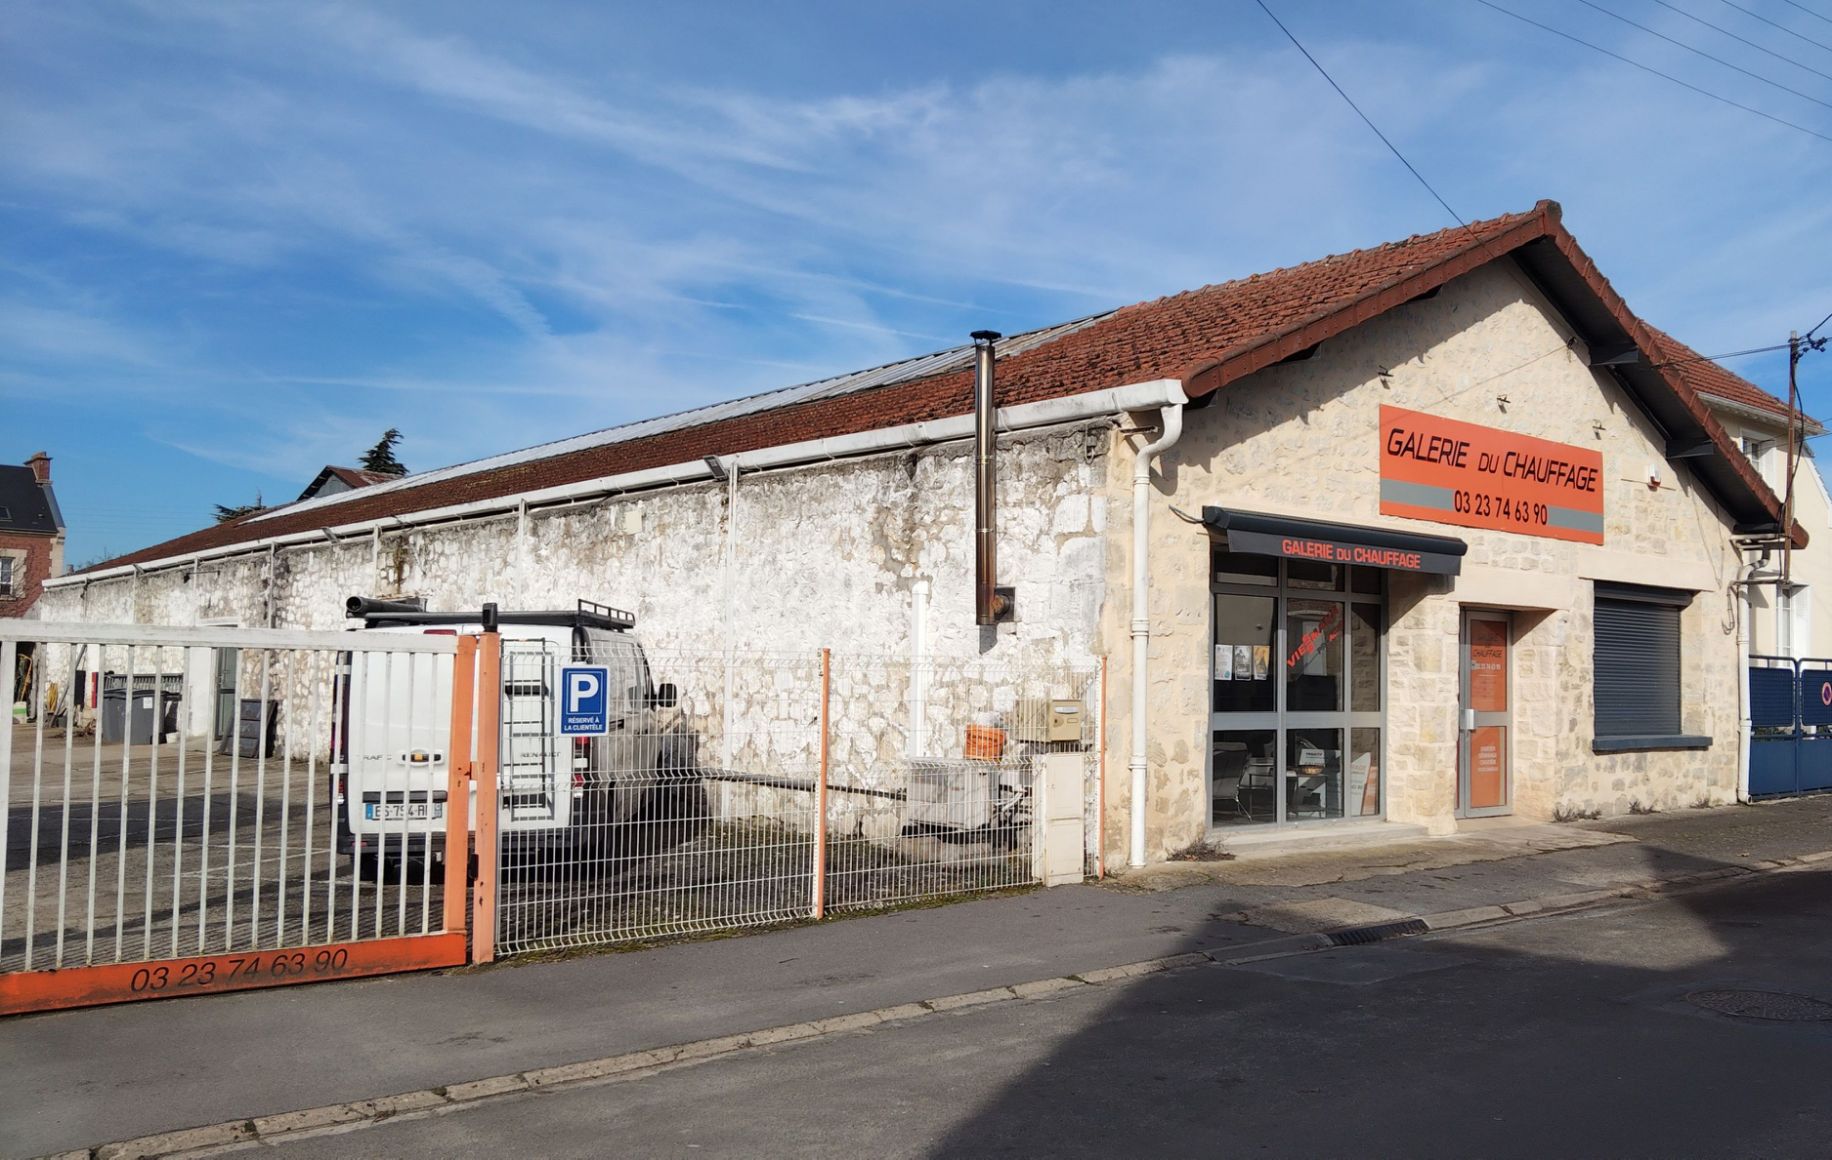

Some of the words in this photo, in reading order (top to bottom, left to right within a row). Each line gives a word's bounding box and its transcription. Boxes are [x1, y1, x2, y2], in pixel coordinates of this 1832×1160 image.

[1387, 428, 1470, 468] GALERIE
[1478, 453, 1500, 474] DU
[1503, 452, 1598, 492] CHAUFFAGE
[1454, 490, 1470, 513] 03
[1475, 493, 1490, 516] 23
[1495, 497, 1510, 519] 74
[1515, 500, 1529, 522] 63
[1533, 503, 1547, 525] 90
[1282, 539, 1333, 559] GALERIE
[1336, 548, 1351, 560] DU
[1354, 548, 1421, 568] CHAUFFAGE
[570, 674, 599, 712] P
[572, 723, 603, 731] CLIENTÈLE
[131, 967, 169, 993] 03
[178, 962, 216, 987] 23
[228, 957, 261, 981] 74
[271, 953, 306, 977] 63
[315, 948, 348, 973] 90
